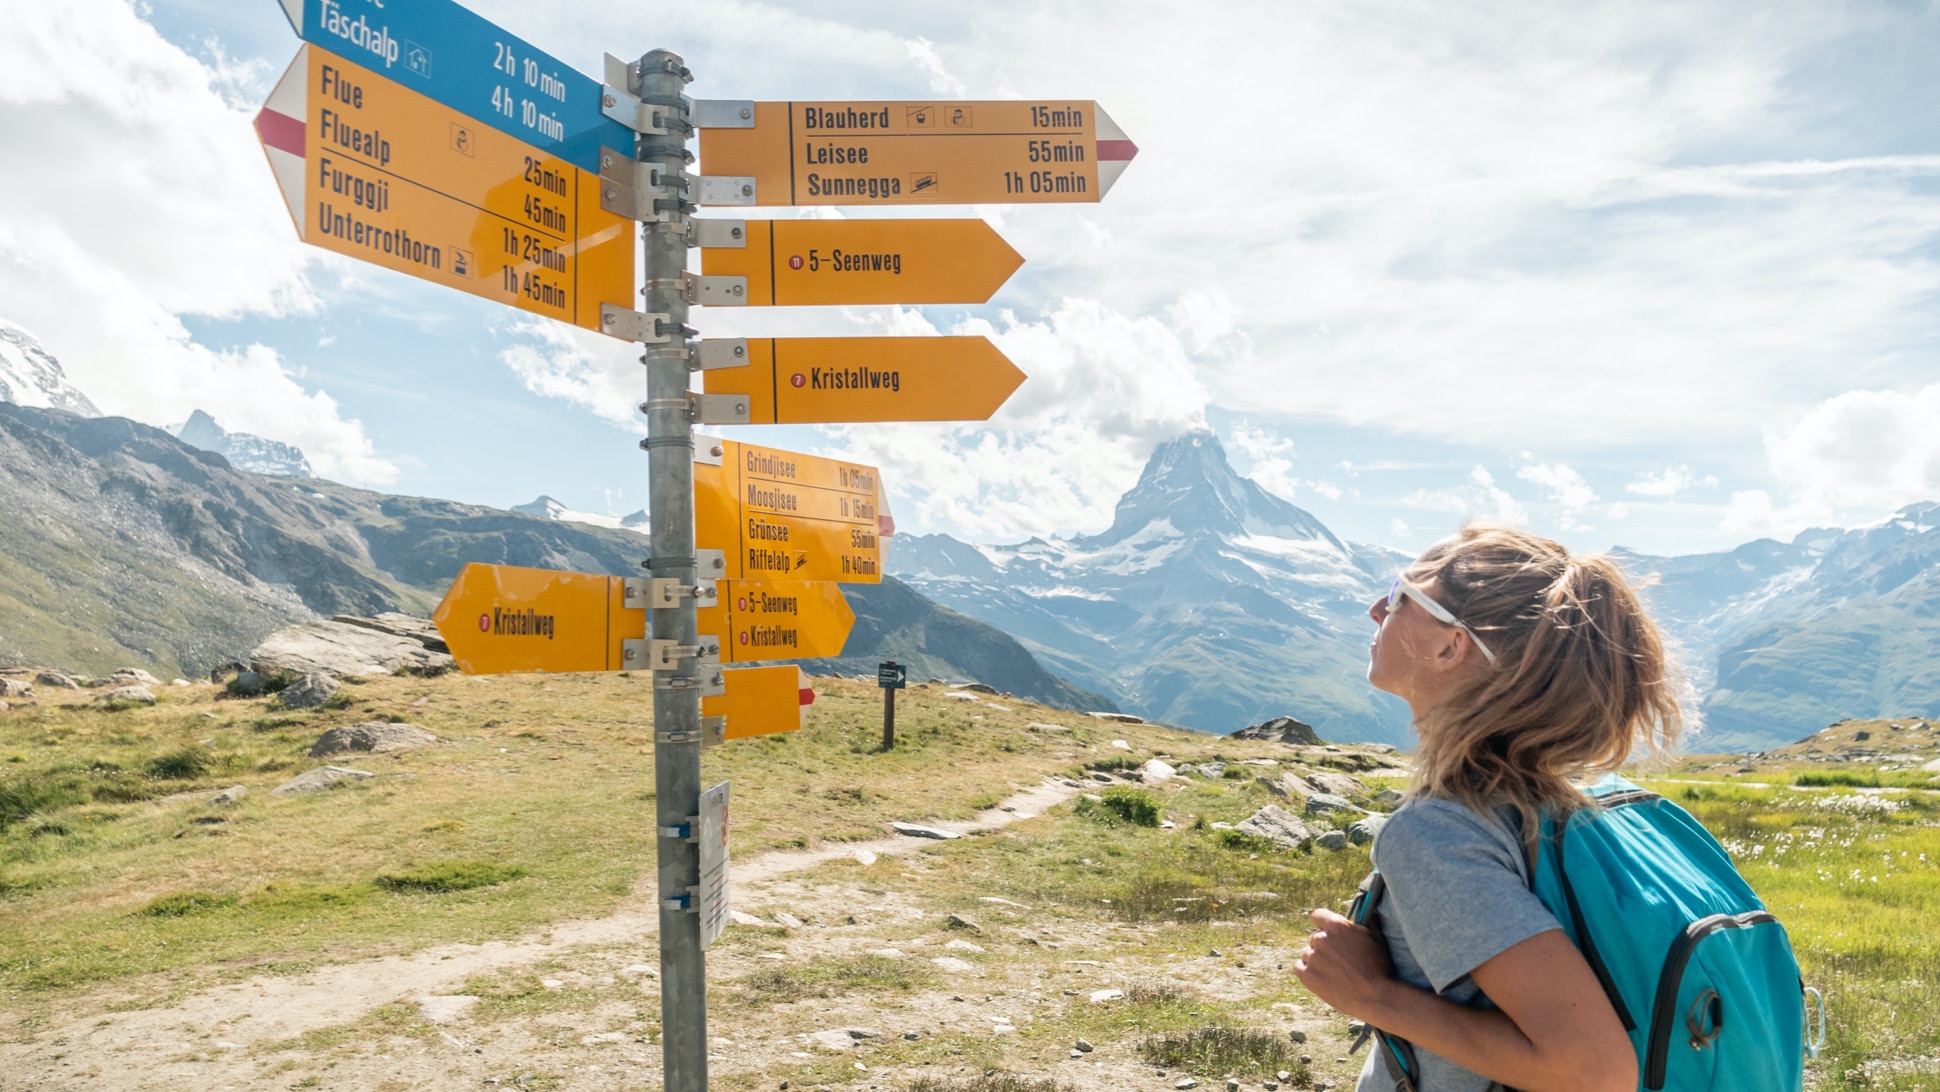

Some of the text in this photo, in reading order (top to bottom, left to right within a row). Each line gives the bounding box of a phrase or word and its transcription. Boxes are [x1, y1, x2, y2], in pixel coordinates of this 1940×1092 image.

[320, 0, 399, 69] Täschalp
[322, 64, 567, 198] Flue 25min
[805, 105, 1083, 129] Blauherd 15min
[806, 140, 1085, 165] Leisee 55min
[321, 108, 567, 234] Fluealp 45min
[807, 170, 1087, 199] Sunnegga 1h 05min
[320, 157, 566, 274] Furggji 1h 25min
[319, 201, 566, 310] Unterrothorn 1h 45min
[809, 249, 901, 275] 5-Seenweg
[811, 366, 900, 392] Kristallweg
[746, 450, 797, 479] Grindjisee
[839, 467, 848, 487] 1h
[747, 483, 798, 512] Moosjisee
[840, 497, 849, 517] 1h
[748, 518, 876, 549] Grünsee 55min
[749, 547, 791, 575] Riffelalp
[841, 555, 850, 574] 1h
[748, 591, 798, 616] 5-Seenweg
[494, 606, 555, 640] Kristallweg
[750, 625, 798, 649] Kristallweg
